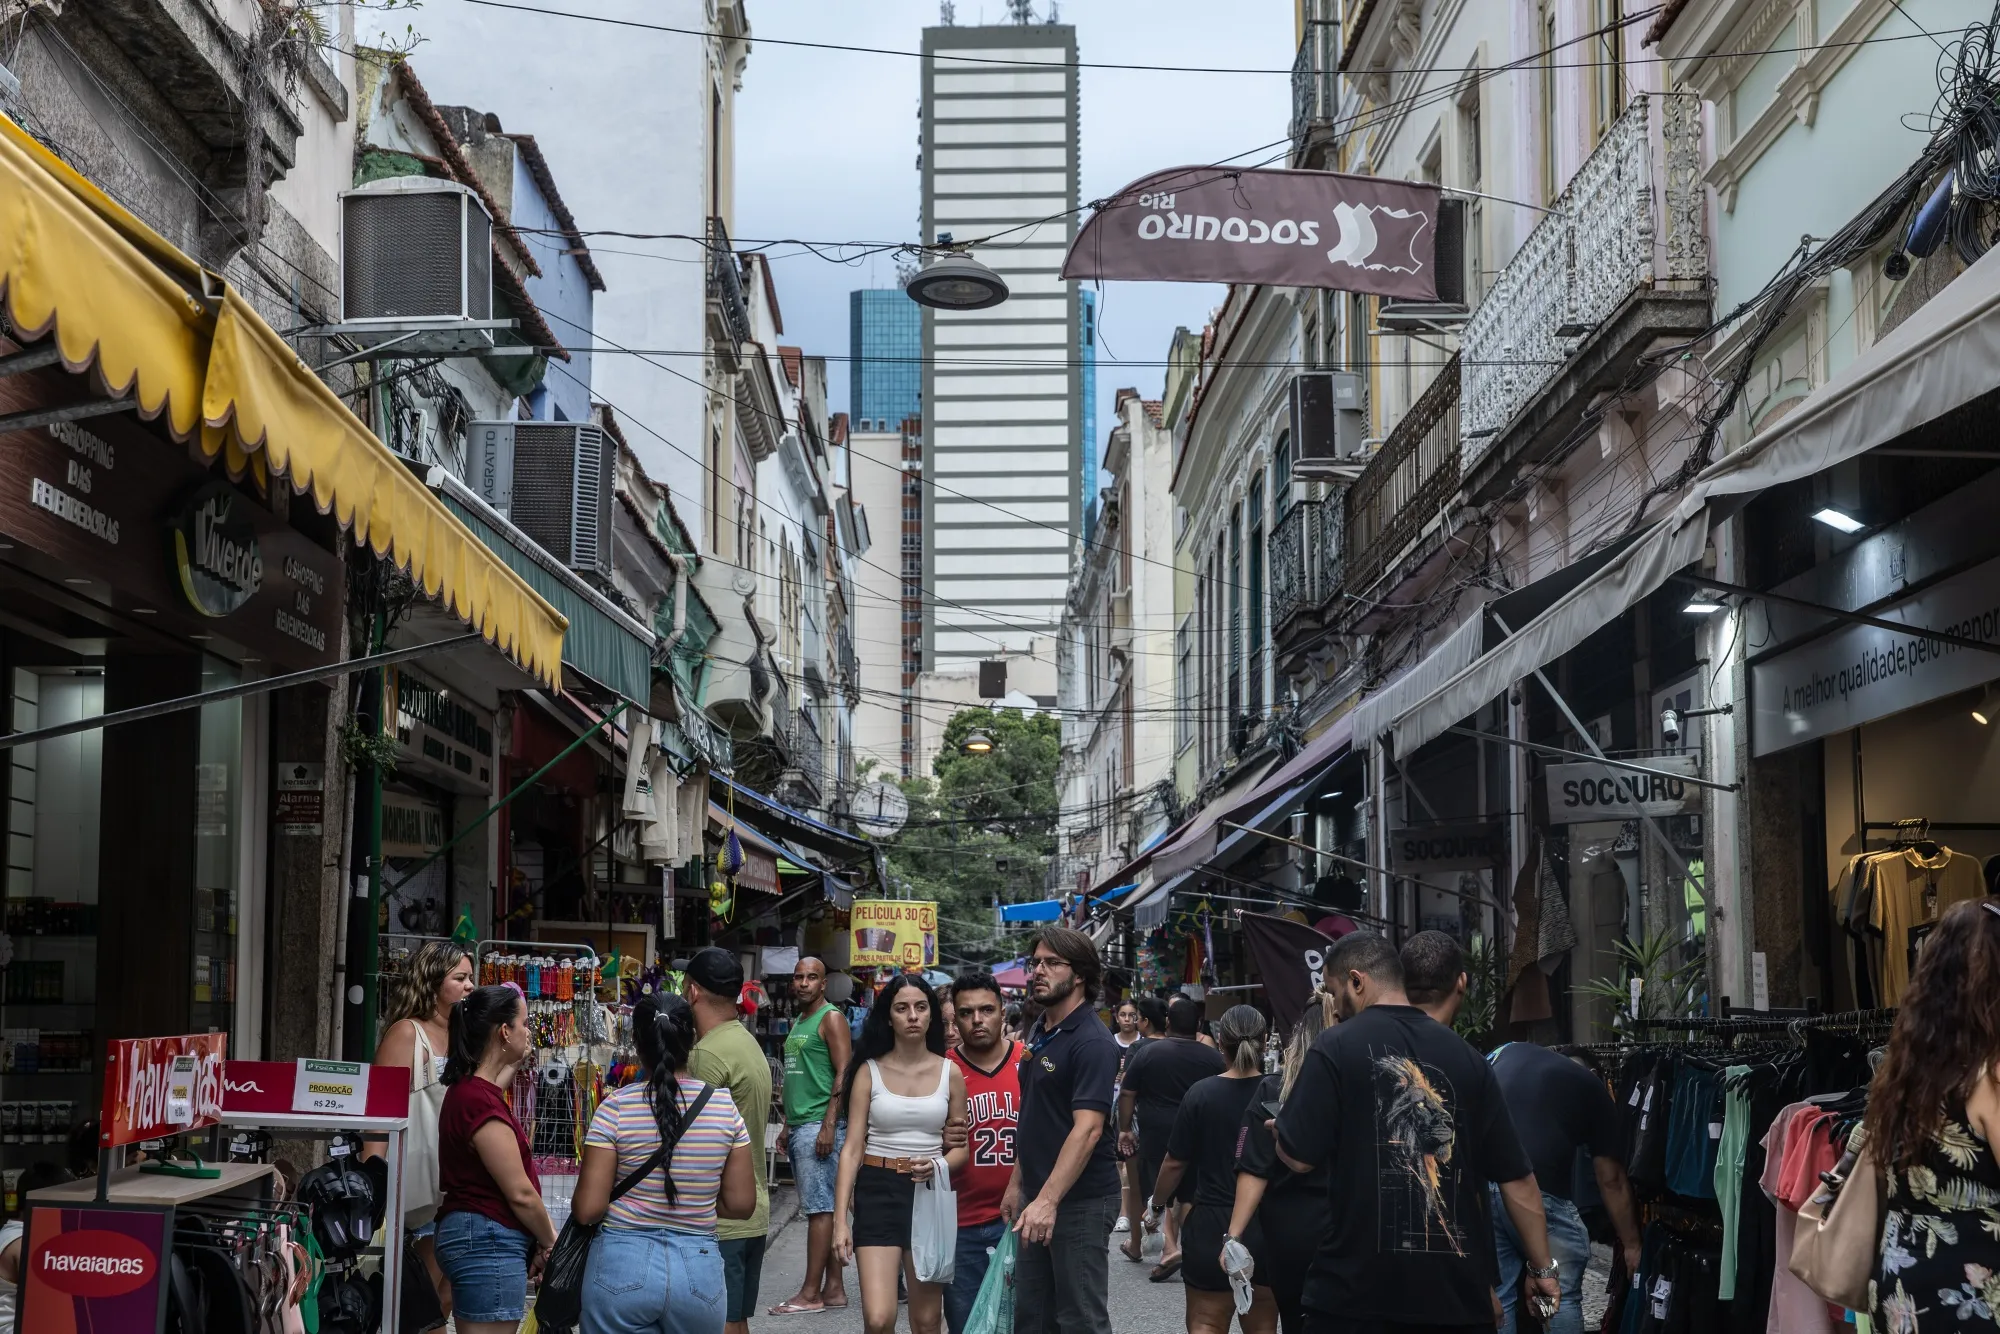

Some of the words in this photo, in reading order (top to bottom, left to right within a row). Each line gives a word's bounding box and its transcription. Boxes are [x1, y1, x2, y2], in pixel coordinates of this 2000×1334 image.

[1137, 210, 1320, 246] SOCOURO
[60, 421, 115, 470] SHOPPING
[68, 459, 92, 494] DAS
[483, 430, 496, 500] AGRATTO
[32, 477, 120, 545] REVENDEDORAS
[290, 558, 324, 595] SHOPPING
[296, 591, 310, 616] DAS
[276, 608, 325, 652] REVENDEDORAS
[1782, 685, 1791, 715] A
[1793, 671, 1836, 711] melhor
[1839, 640, 1908, 702] qualidade,
[1908, 625, 1941, 678] pelo
[279, 792, 320, 803] Alarme
[1562, 774, 1685, 808] SOCOURO
[855, 904, 902, 920] PELÍCULA
[905, 908, 918, 921] 3D
[853, 954, 870, 962] CAPAS
[127, 1041, 219, 1131] havnas
[309, 1083, 353, 1096] PROMOÇÃO
[313, 1099, 323, 1108] R$
[966, 1091, 1019, 1130] BULL
[974, 1127, 1017, 1166] 23
[43, 1250, 144, 1275] havaianas
